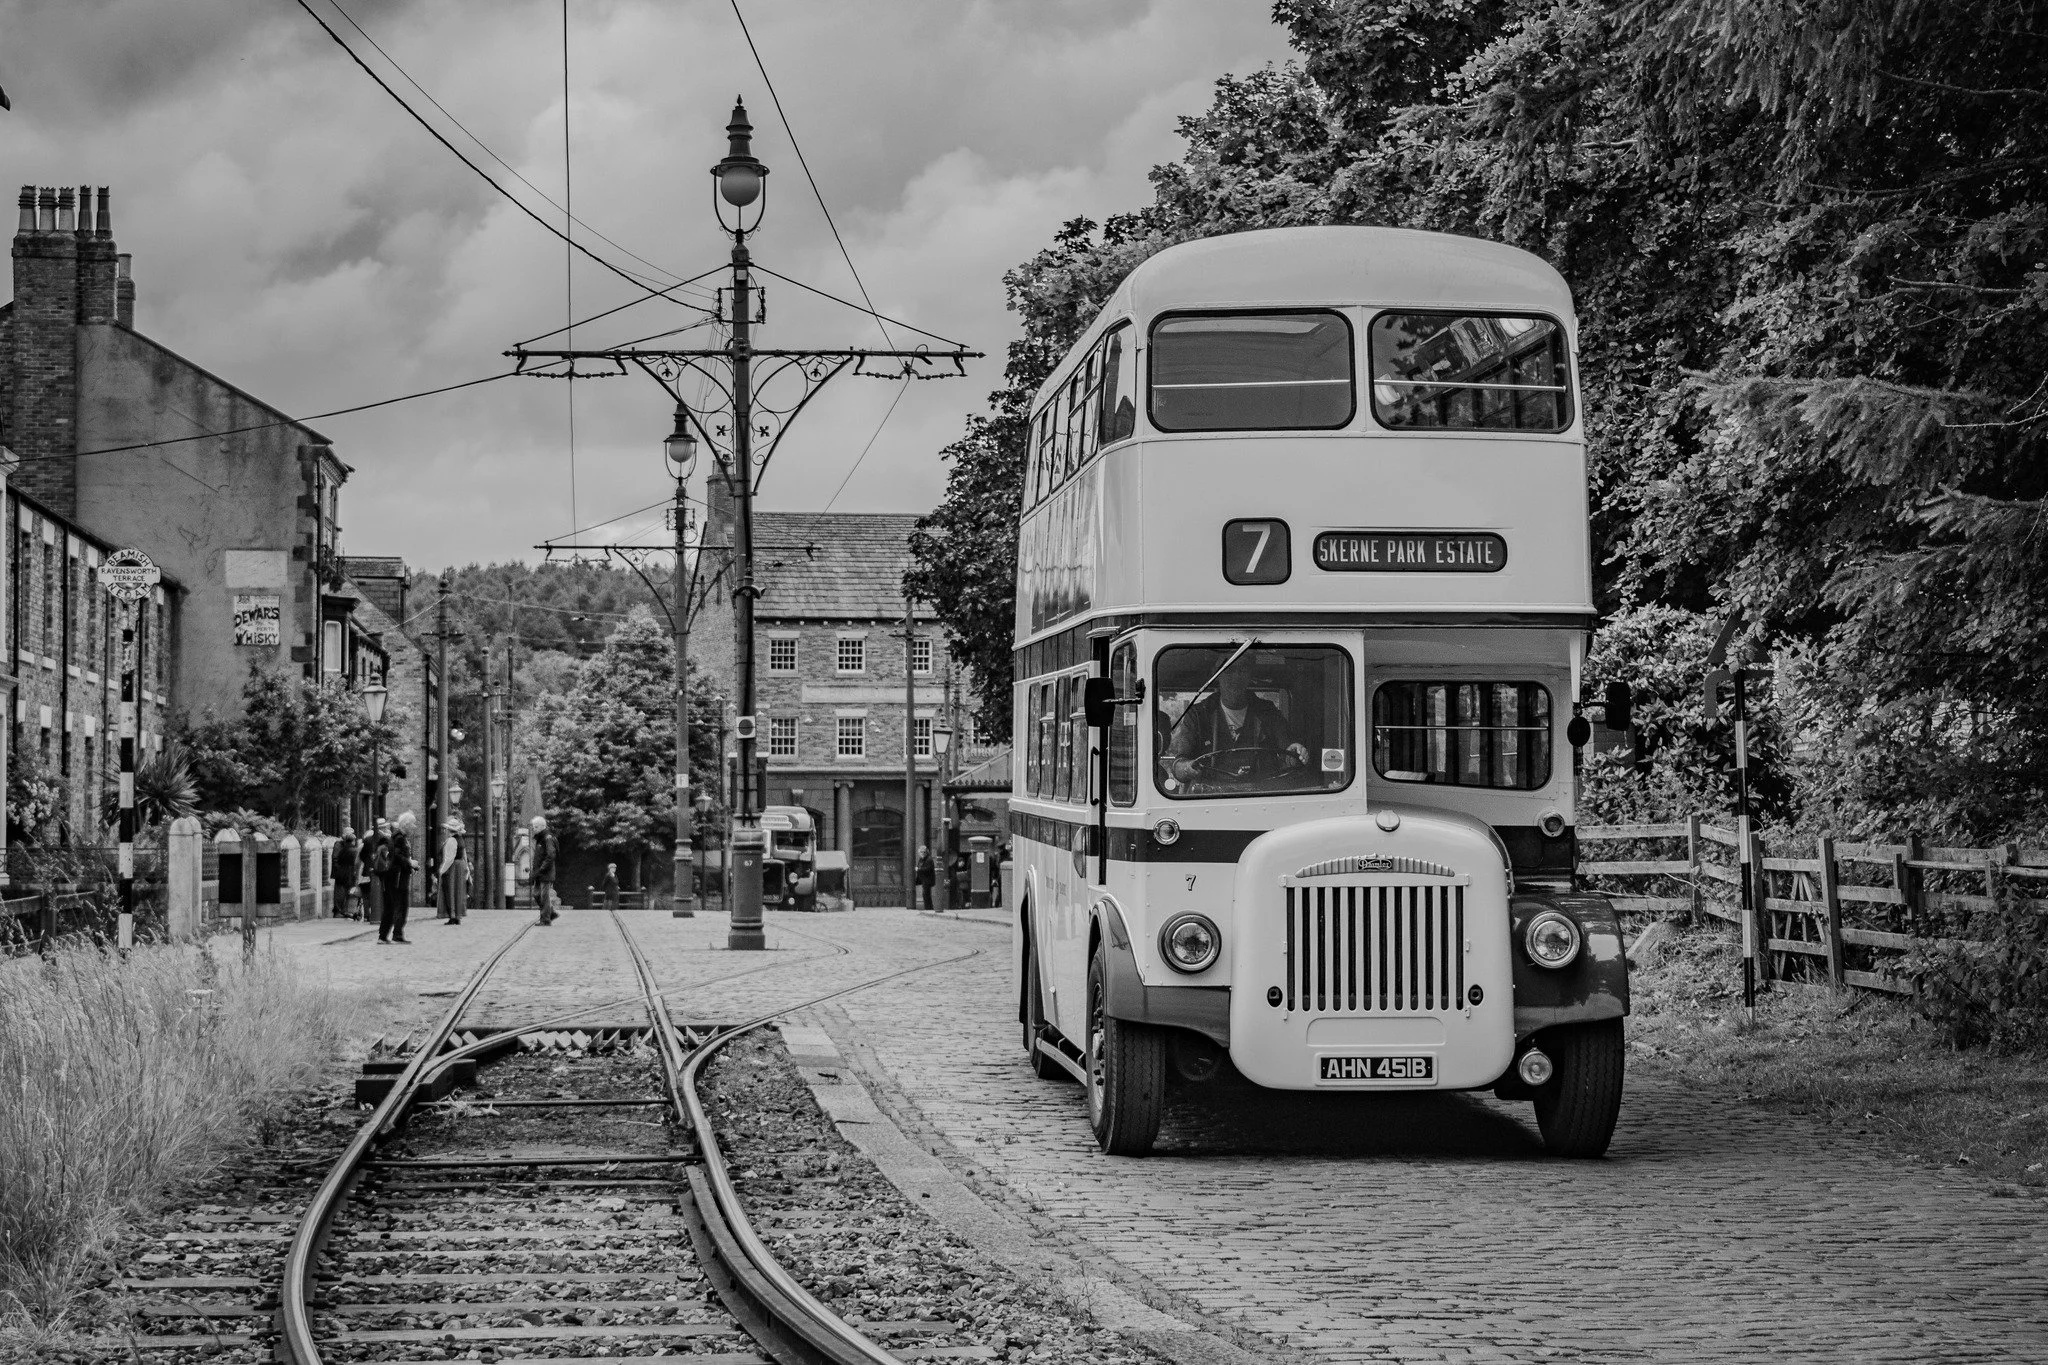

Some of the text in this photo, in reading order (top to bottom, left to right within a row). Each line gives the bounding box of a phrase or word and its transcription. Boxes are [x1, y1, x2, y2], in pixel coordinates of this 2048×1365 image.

[107, 550, 151, 567] BEAMISH
[1242, 524, 1271, 574] 7
[1319, 538, 1495, 564] SKERNE PARK ESTATE
[101, 567, 157, 575] RAVENSWORTH
[234, 606, 280, 628] DEWAR'S
[1185, 873, 1197, 891] 7
[1326, 1058, 1427, 1078] AHN 451B
